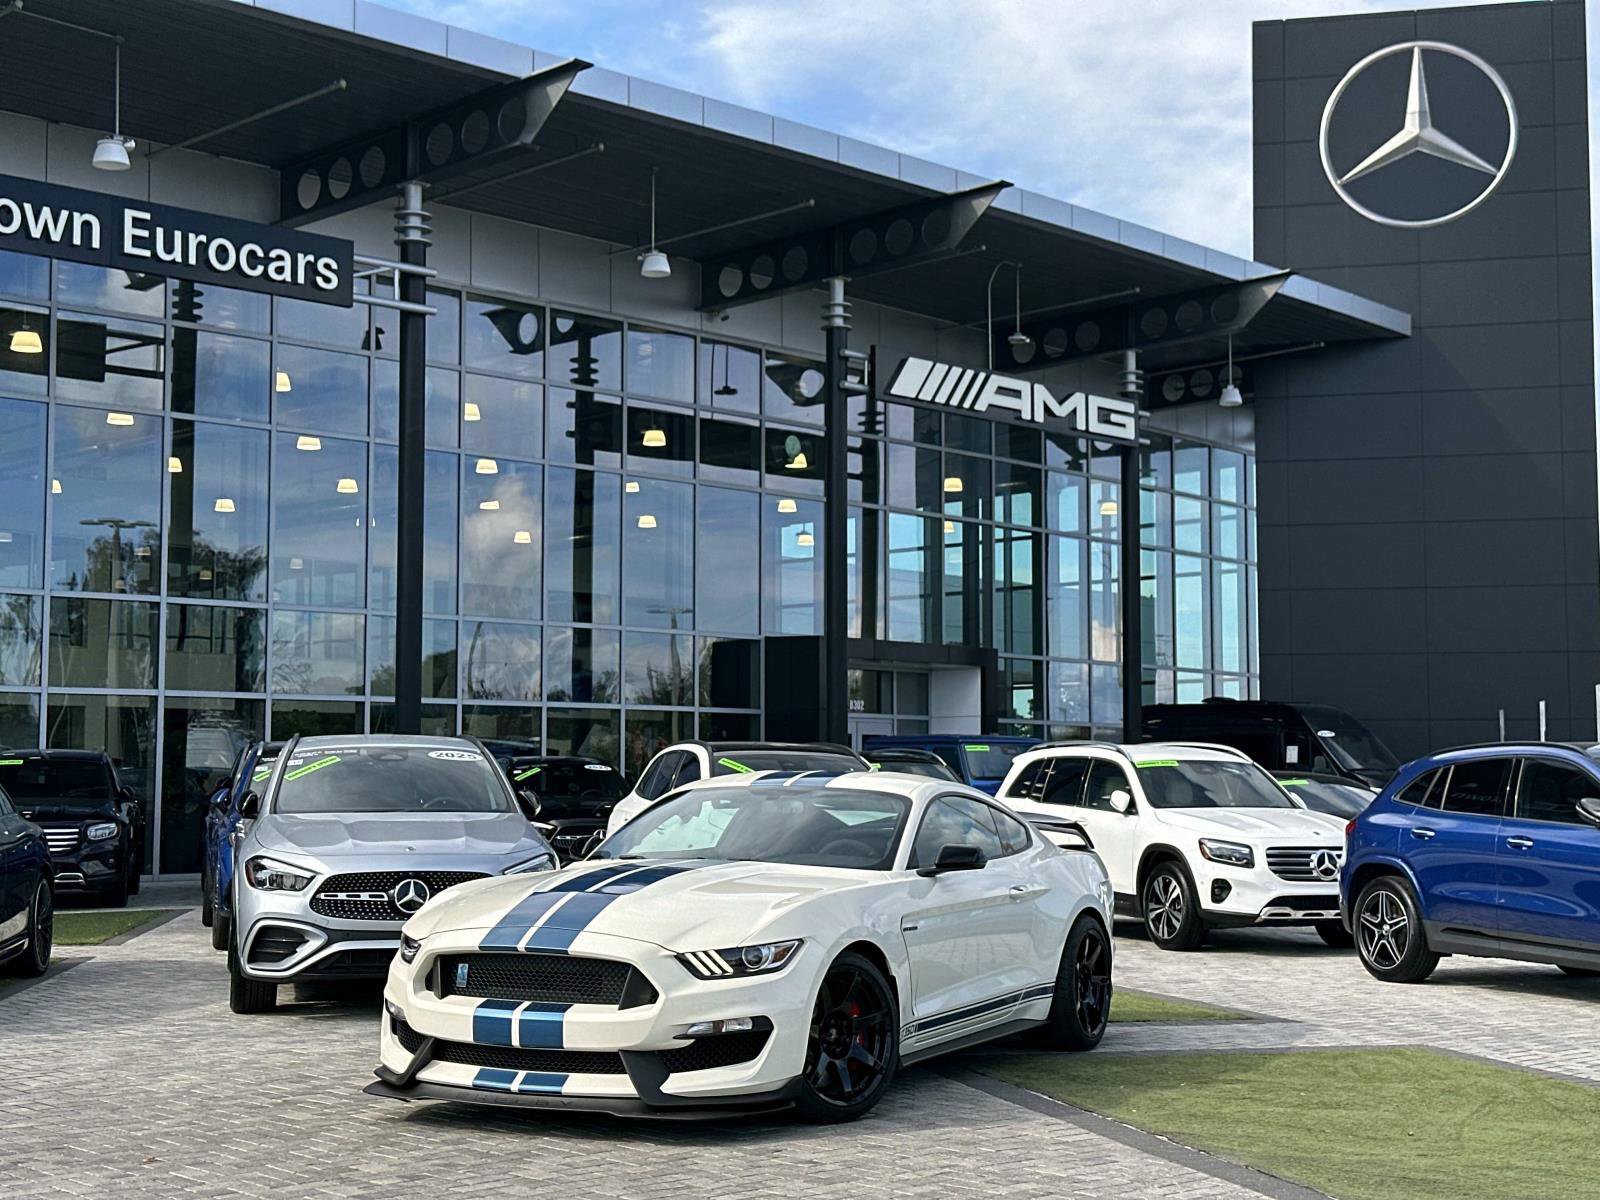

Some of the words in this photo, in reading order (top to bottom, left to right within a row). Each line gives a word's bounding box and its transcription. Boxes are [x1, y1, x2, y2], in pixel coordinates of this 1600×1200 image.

[0, 198, 101, 249] own
[123, 208, 339, 290] Eurocars
[974, 374, 1135, 440] AMG
[434, 752, 477, 760] 2025
